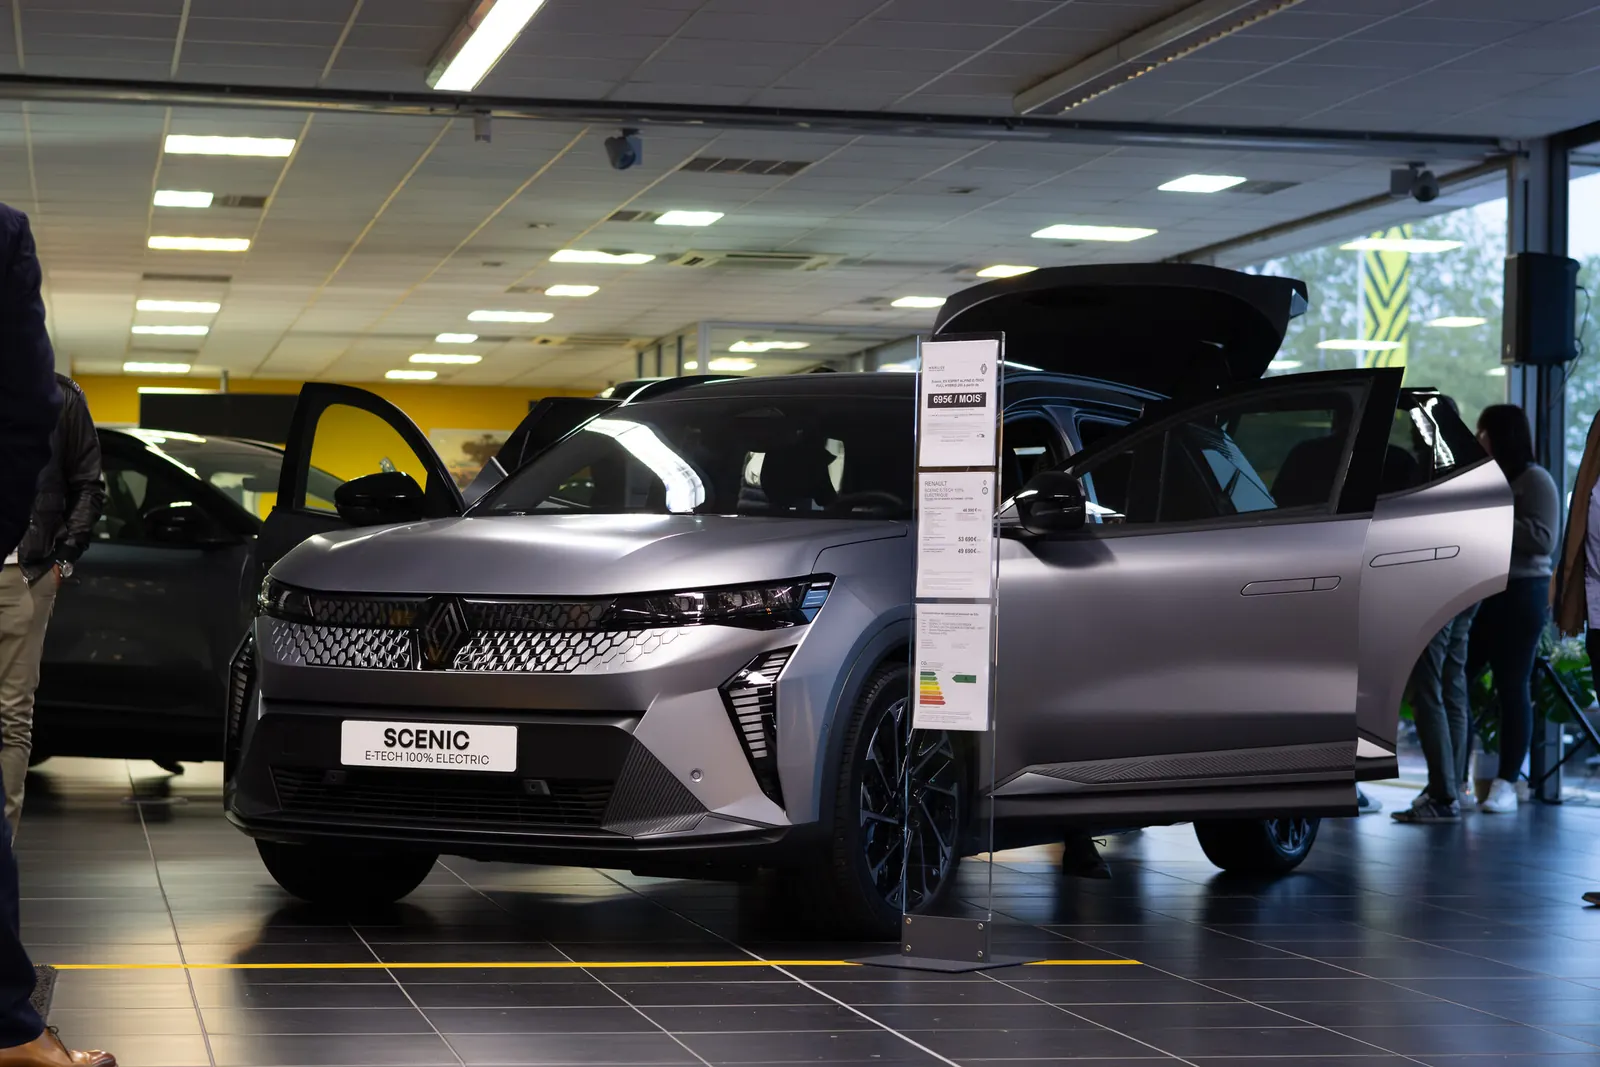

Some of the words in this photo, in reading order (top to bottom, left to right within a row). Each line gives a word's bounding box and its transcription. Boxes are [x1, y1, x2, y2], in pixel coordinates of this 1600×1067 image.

[933, 395, 953, 404] 695€
[954, 394, 958, 404] /
[384, 728, 470, 751] SCENIC
[365, 750, 403, 762] E-TECH
[406, 752, 433, 763] 100%
[436, 753, 489, 765] ELECTRIC
